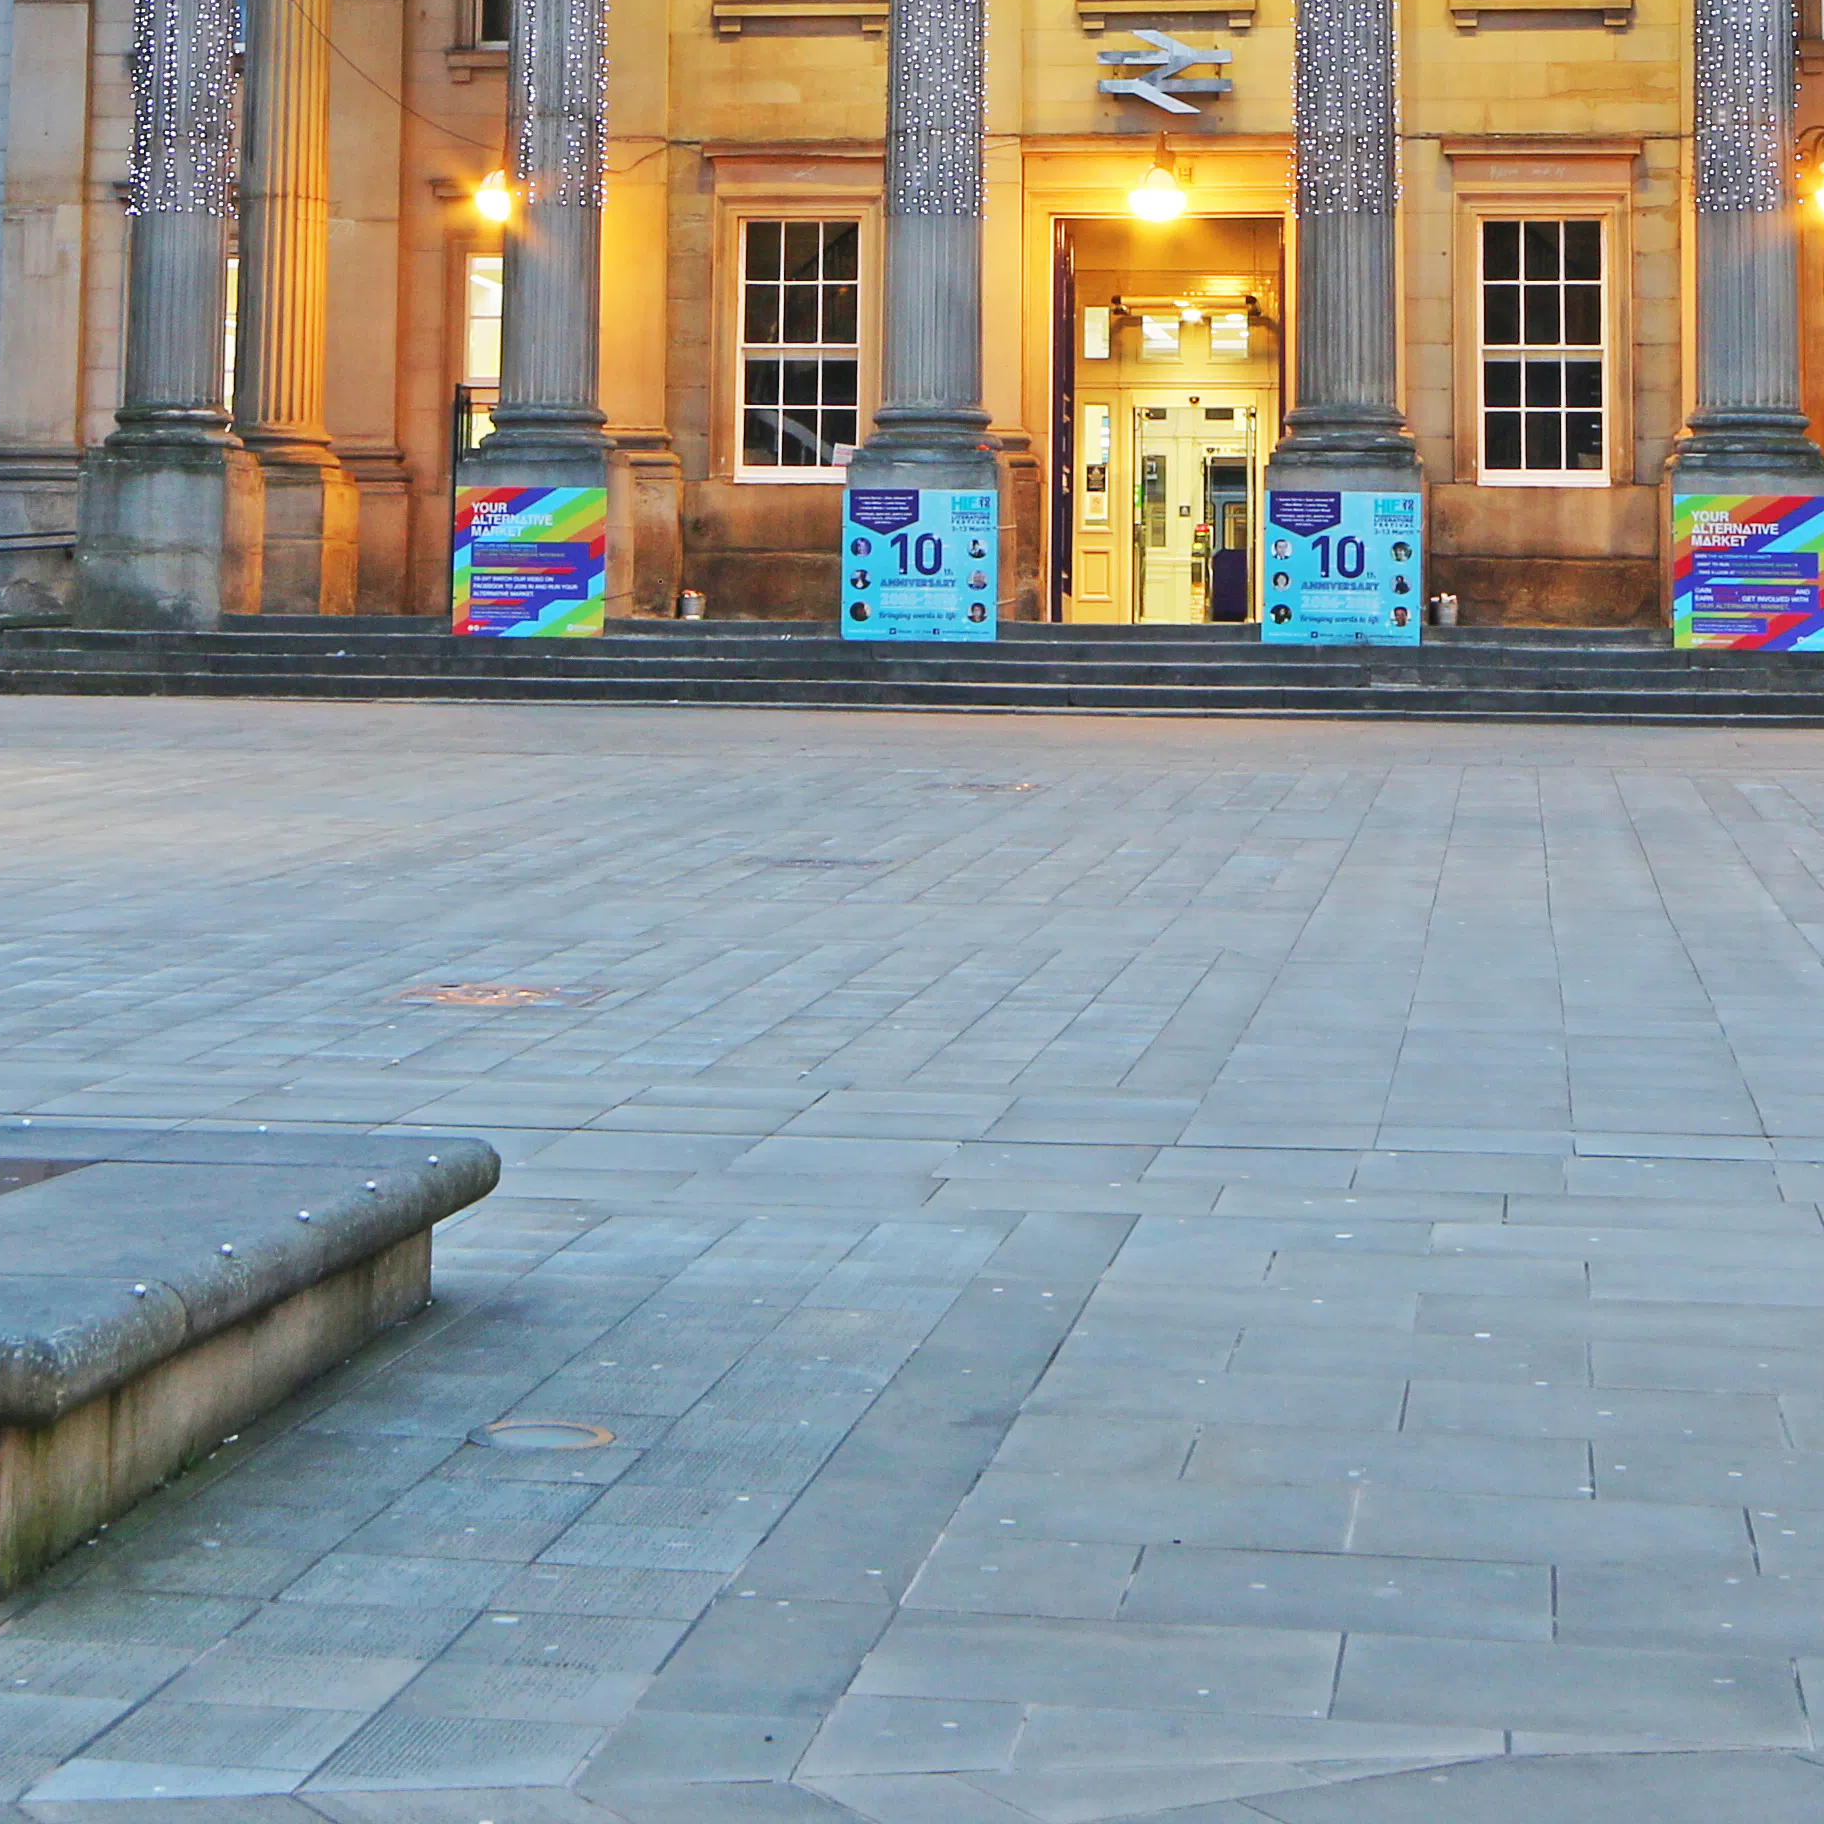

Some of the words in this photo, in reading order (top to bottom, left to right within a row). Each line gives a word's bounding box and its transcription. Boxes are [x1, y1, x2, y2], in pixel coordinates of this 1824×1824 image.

[471, 502, 508, 514] YOUR
[471, 514, 553, 526] ALTERNATIVE
[1691, 511, 1729, 522] YOUR
[470, 526, 523, 537] MARKET
[1691, 523, 1779, 535] ALTERNATIVE
[1691, 535, 1747, 546] MARKET
[880, 579, 956, 588] ANNIVERSARY
[1301, 581, 1379, 590] ANNIVERSARY
[879, 612, 911, 621] Bringing
[1300, 614, 1333, 623] Bringing
